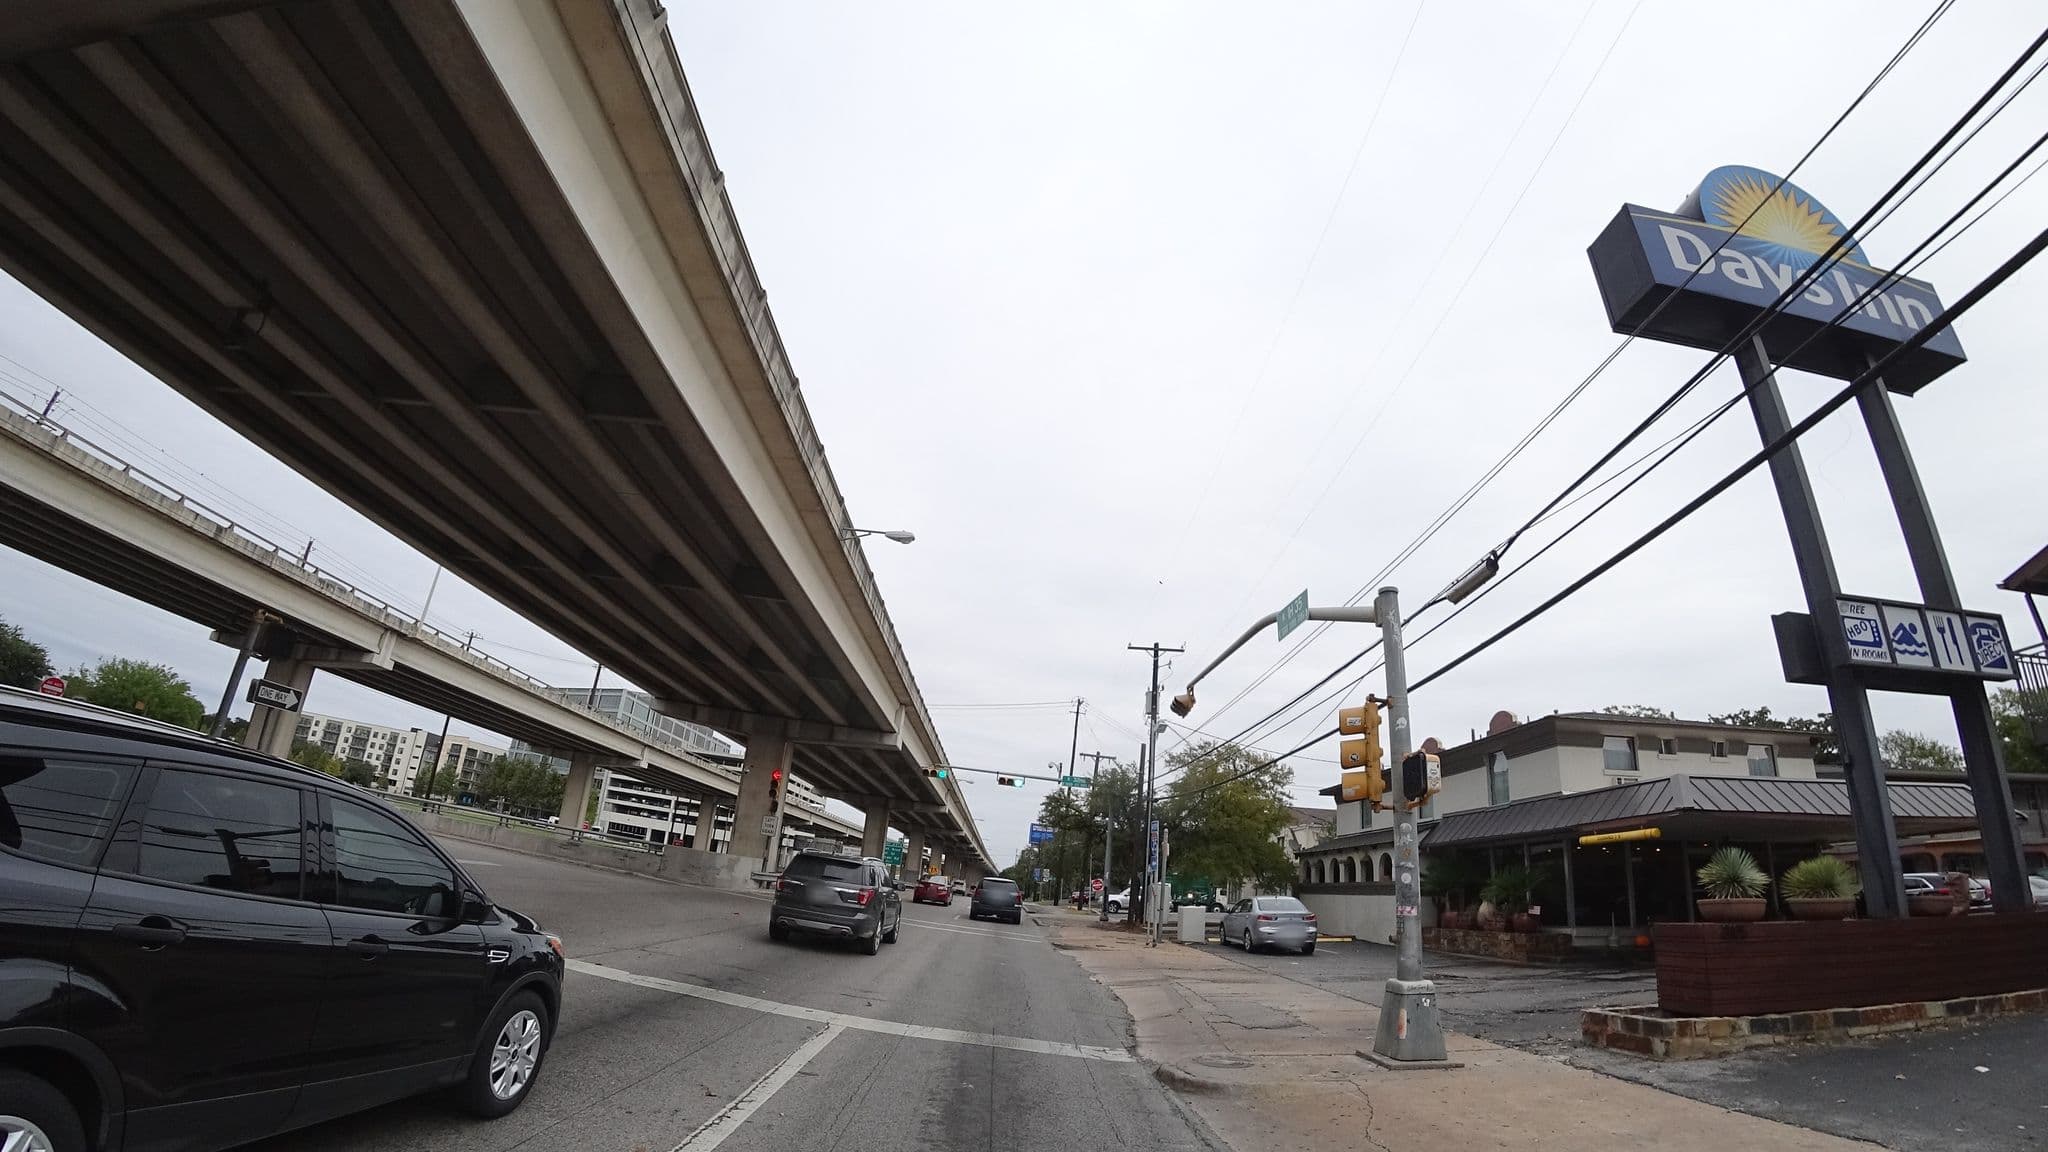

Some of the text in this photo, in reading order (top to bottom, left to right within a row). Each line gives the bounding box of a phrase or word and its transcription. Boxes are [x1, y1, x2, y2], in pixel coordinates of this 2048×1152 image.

[1659, 224, 1941, 335] Days Inn
[1847, 621, 1868, 638] HBO
[1862, 649, 1888, 660] ROOMS
[1977, 640, 2005, 665] DIRECT
[260, 687, 288, 701] ONE WAY
